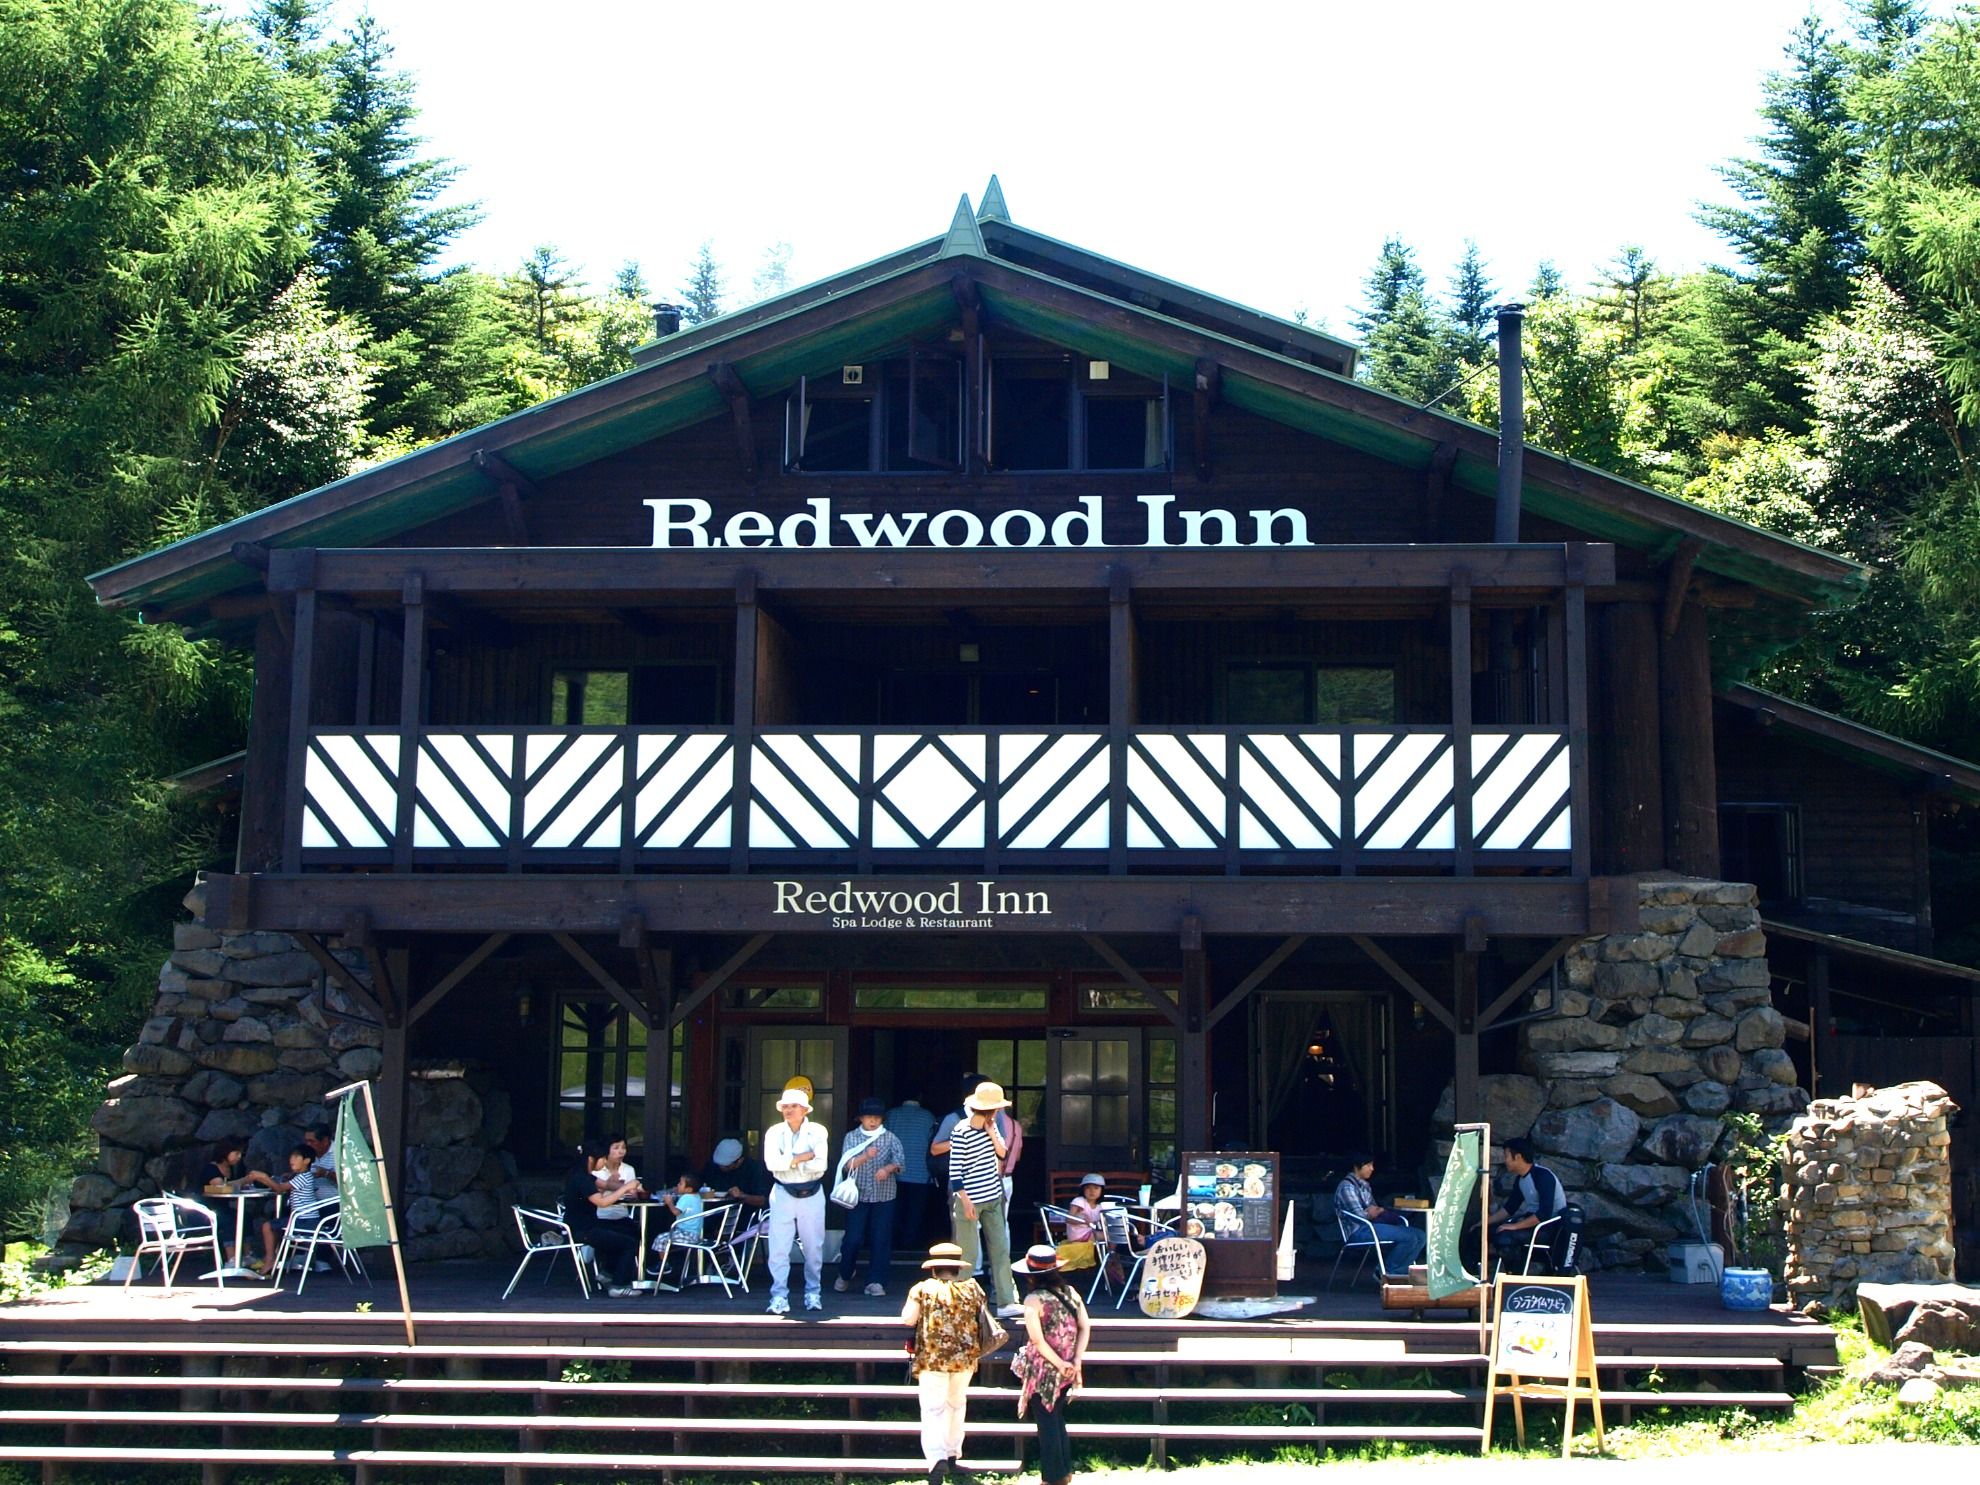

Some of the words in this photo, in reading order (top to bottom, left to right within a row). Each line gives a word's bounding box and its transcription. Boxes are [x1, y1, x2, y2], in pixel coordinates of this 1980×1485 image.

[643, 496, 1102, 547] Redwood
[1137, 495, 1315, 547] Inn
[773, 881, 963, 914] Redwood
[976, 881, 1052, 914] Inn
[832, 917, 857, 929] Spa
[861, 917, 902, 928] Lodge
[905, 917, 916, 928] &
[920, 917, 993, 928] Restaurant
